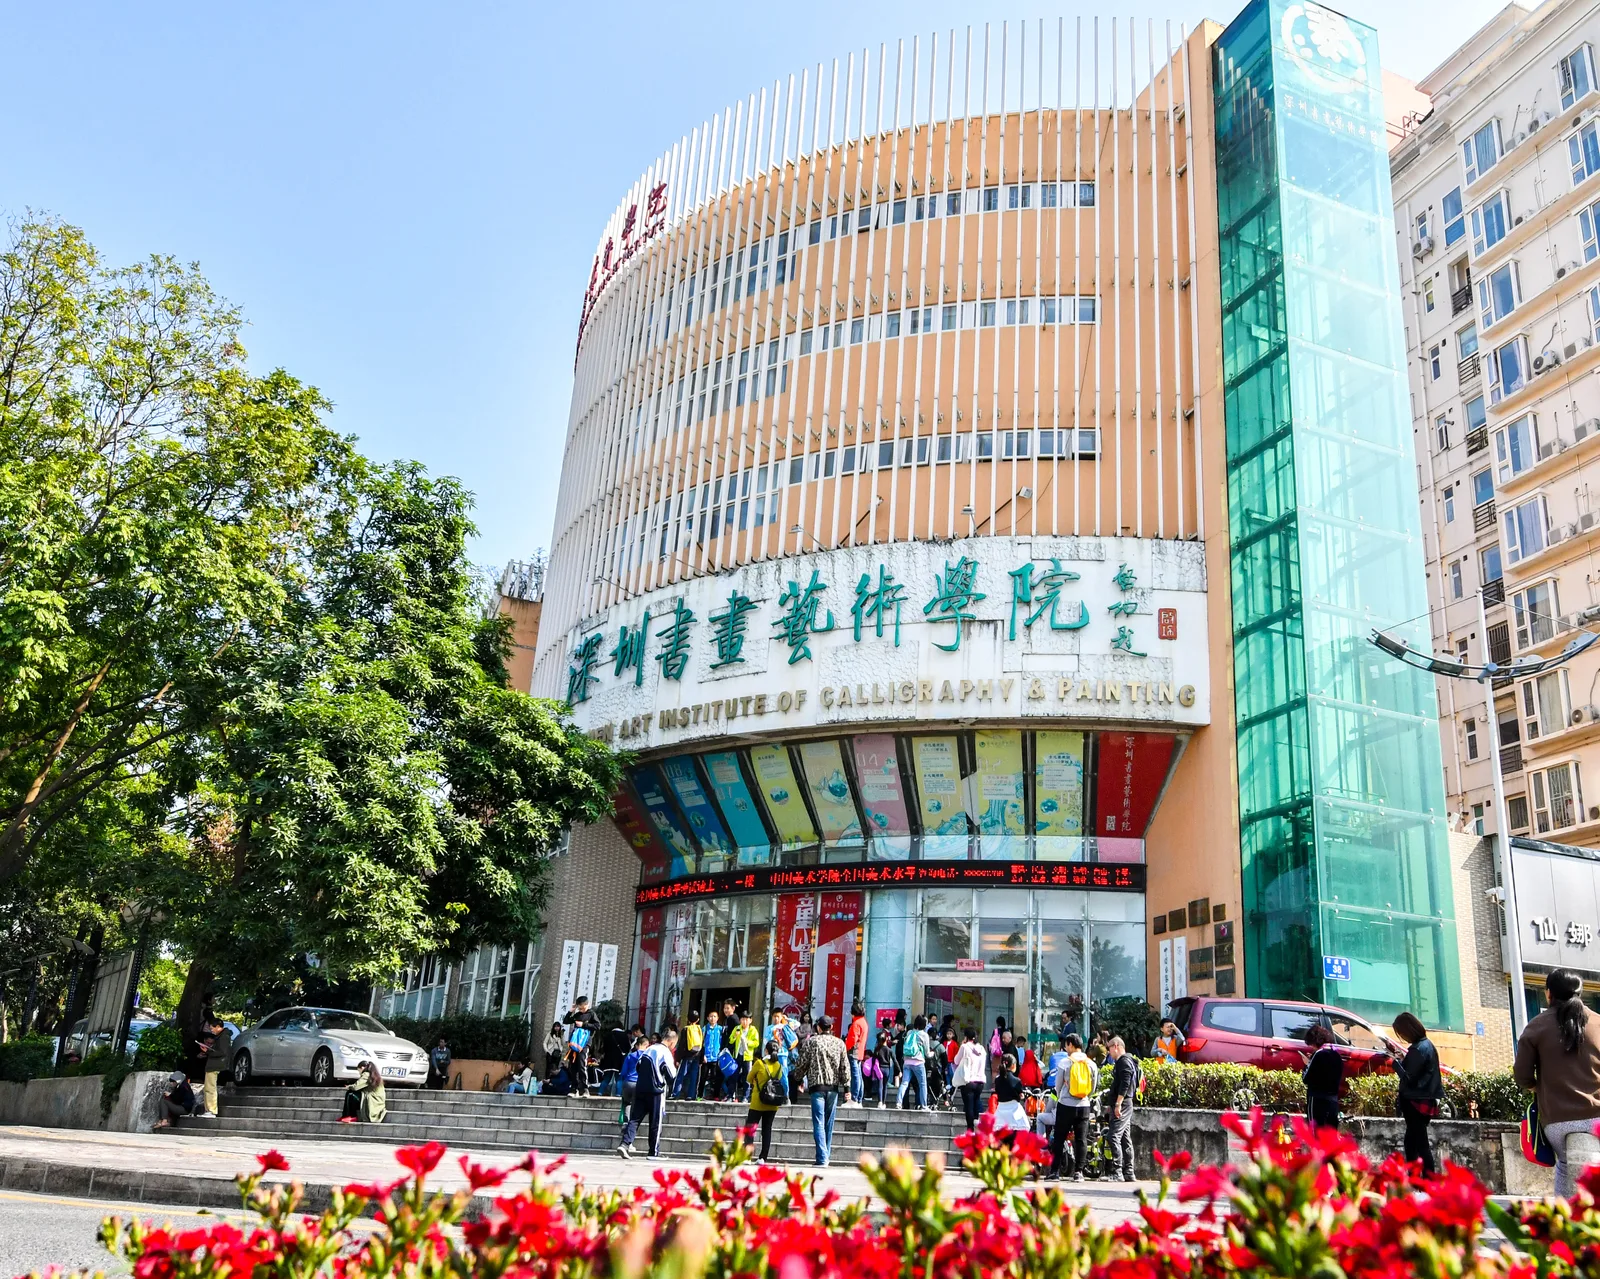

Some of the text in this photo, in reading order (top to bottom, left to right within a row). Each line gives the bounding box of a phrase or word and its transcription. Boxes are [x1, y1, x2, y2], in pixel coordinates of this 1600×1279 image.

[619, 712, 653, 739] ART
[659, 693, 767, 730] INSTITUTE
[777, 689, 807, 713] OF
[819, 678, 1014, 708] CALLIGRAPHY
[1028, 677, 1045, 700] &
[1058, 678, 1196, 707] PAINTING
[1332, 964, 1342, 974] 38
